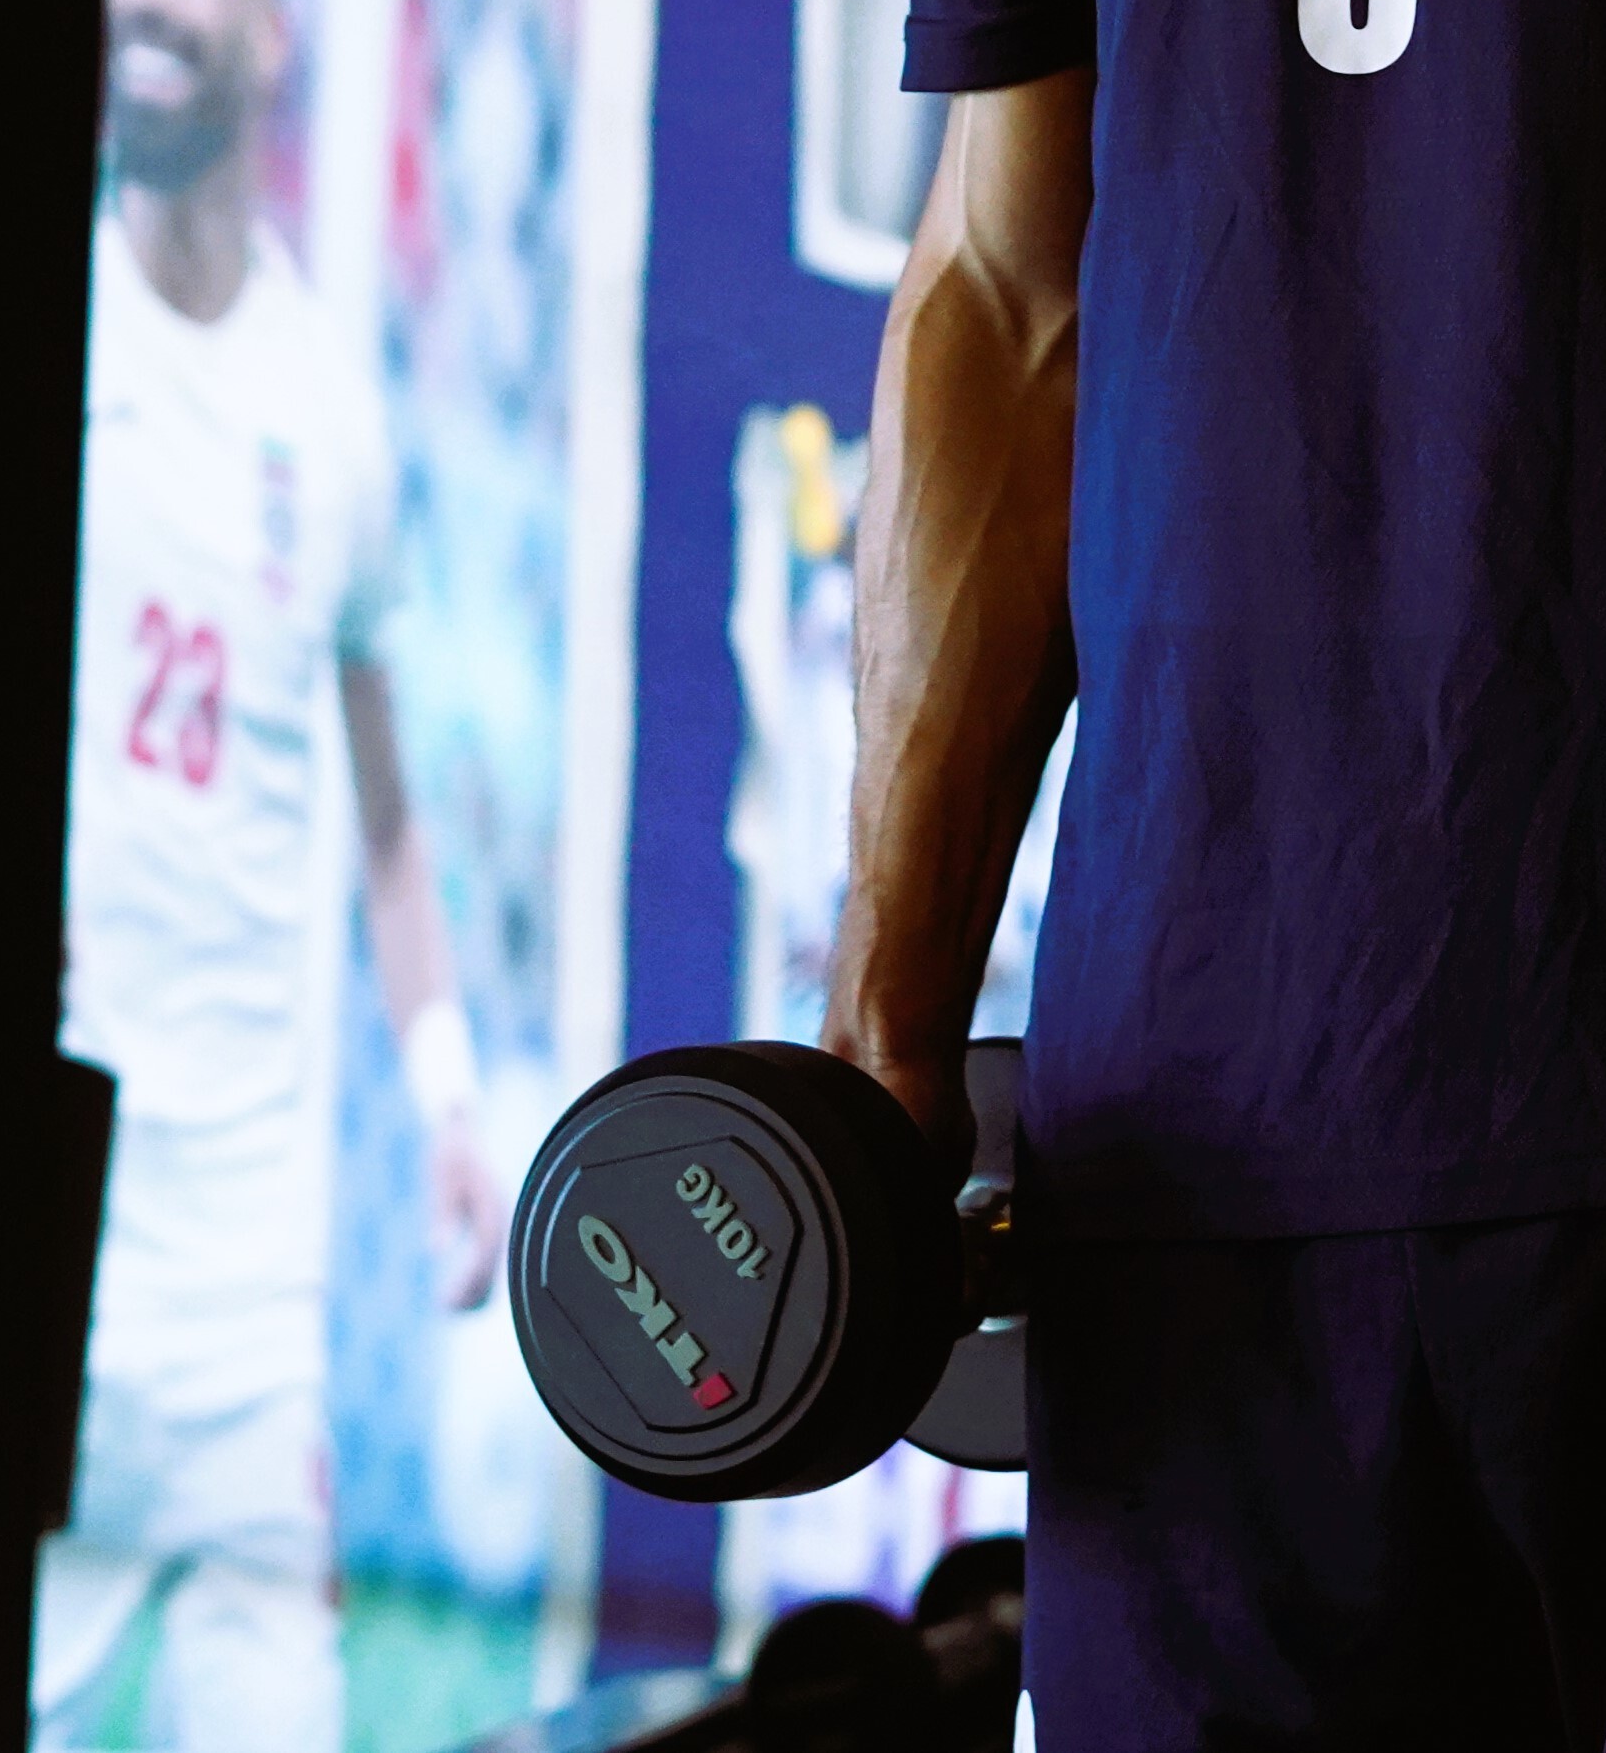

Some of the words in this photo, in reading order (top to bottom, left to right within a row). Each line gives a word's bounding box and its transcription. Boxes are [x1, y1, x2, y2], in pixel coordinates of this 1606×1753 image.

[128, 599, 225, 789] 23
[577, 1214, 709, 1387] TKO
[675, 1163, 773, 1280] 10KG
